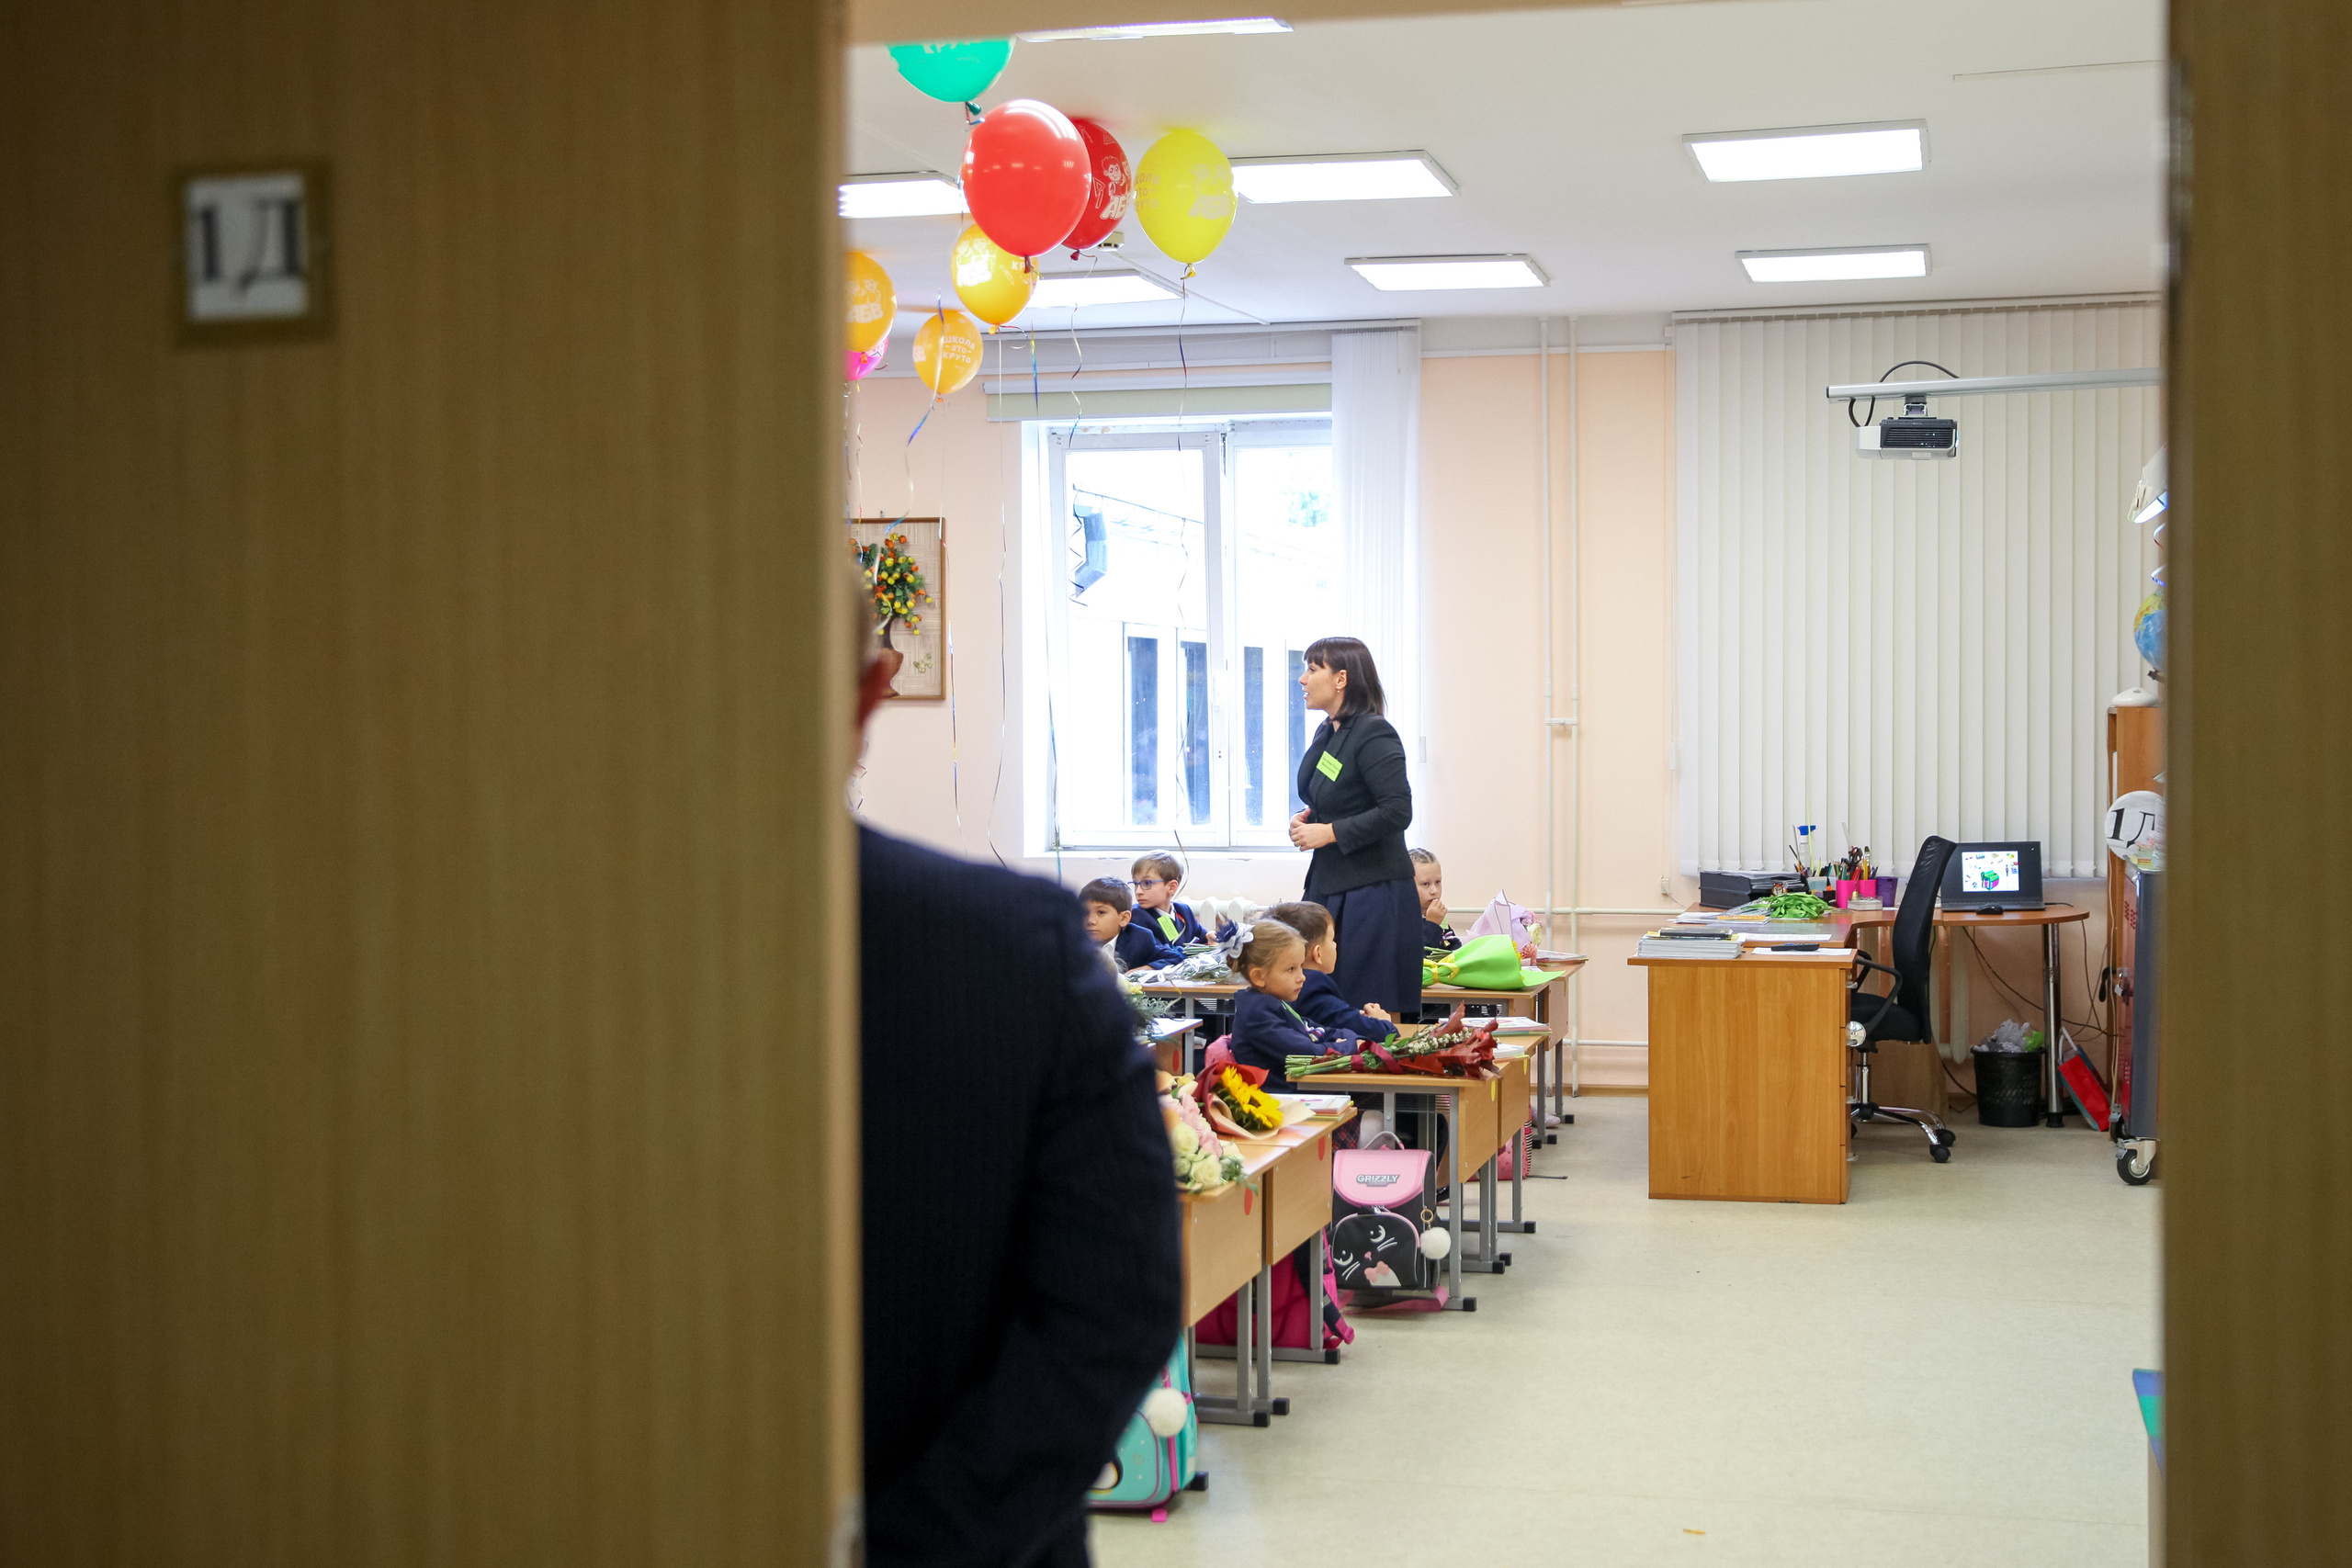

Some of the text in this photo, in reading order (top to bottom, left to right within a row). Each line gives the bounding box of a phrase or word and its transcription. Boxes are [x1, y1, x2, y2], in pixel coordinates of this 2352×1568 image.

[1188, 195, 1231, 220] АБВ
[944, 335, 976, 350] ШКОЛА
[943, 352, 971, 364] КРУТО
[1357, 1175, 1398, 1183] GRIZZLY
